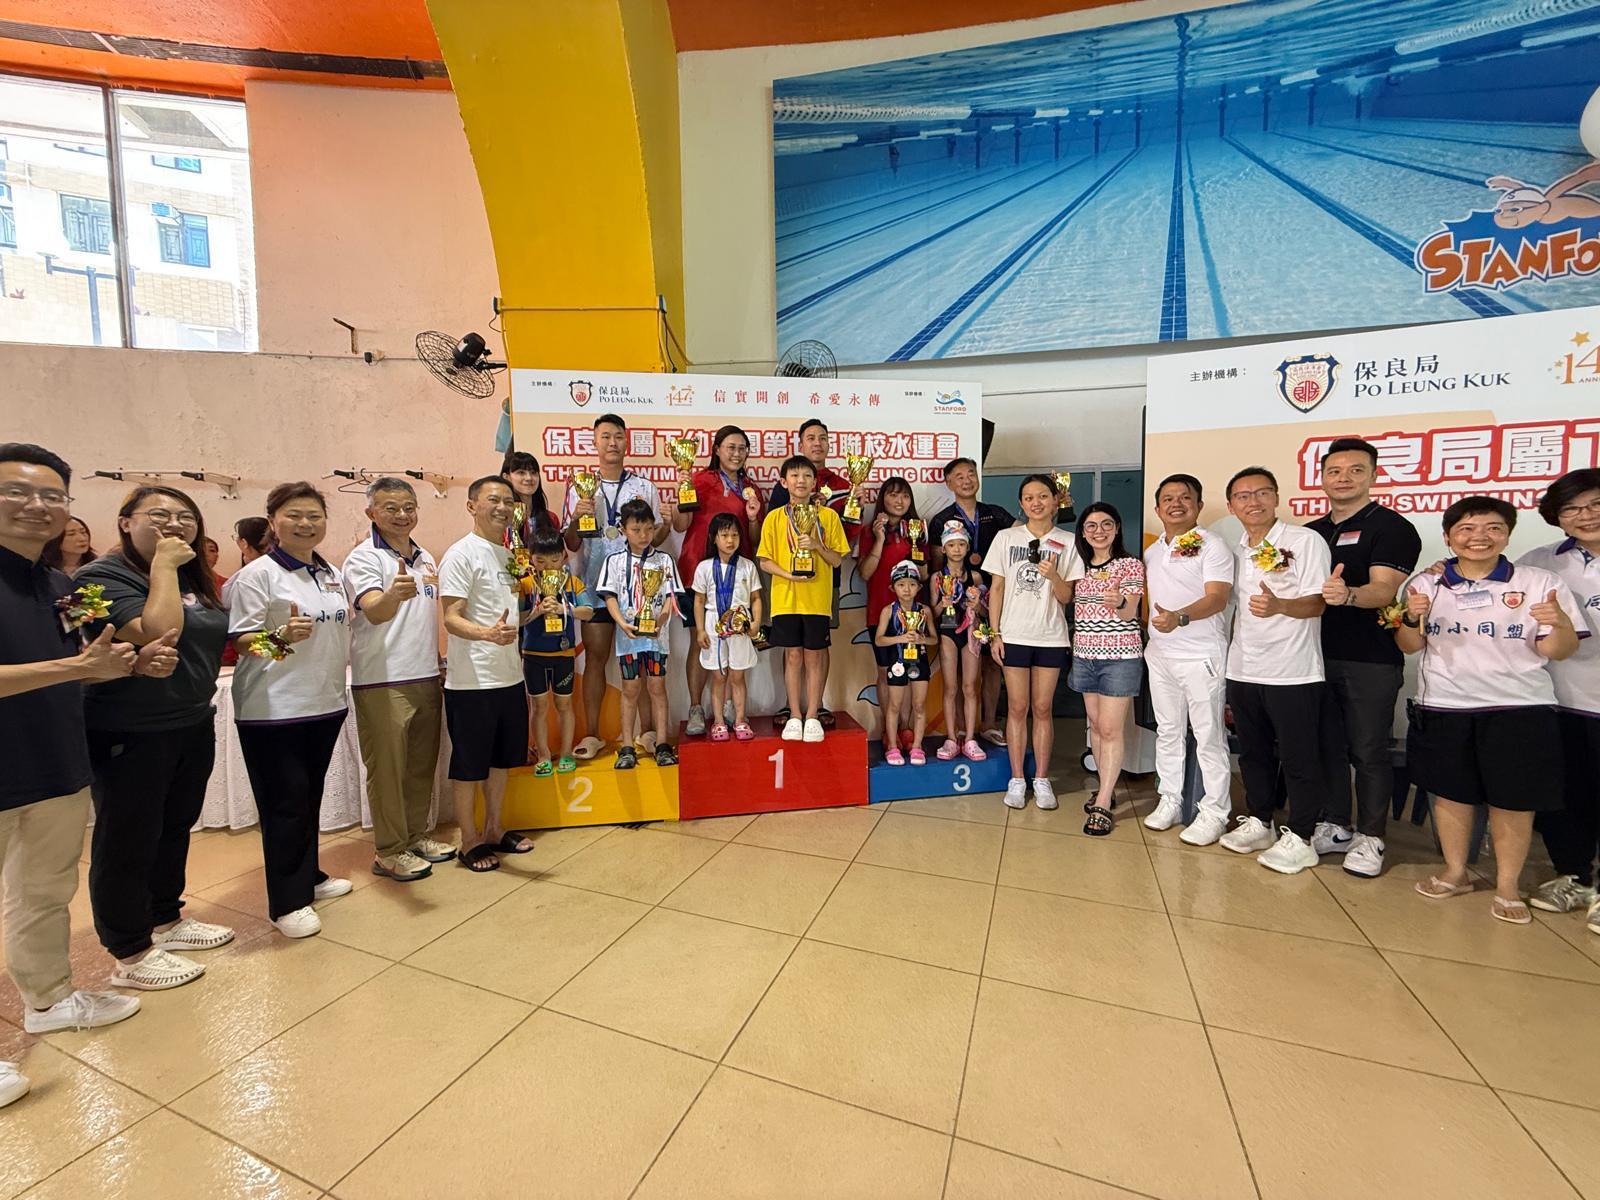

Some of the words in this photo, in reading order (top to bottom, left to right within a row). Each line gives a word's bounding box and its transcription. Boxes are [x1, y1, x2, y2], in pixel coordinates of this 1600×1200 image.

[1354, 354, 1440, 382] 保良局
[599, 385, 630, 396] 保良局
[713, 389, 789, 405] 信實開創
[808, 391, 881, 407] 希愛永傳
[1354, 383, 1382, 398] PO
[1388, 377, 1457, 395] LEUNG
[1464, 372, 1511, 389] KUK
[767, 748, 784, 789] 1
[952, 763, 972, 792] 3
[567, 776, 593, 813] 2
